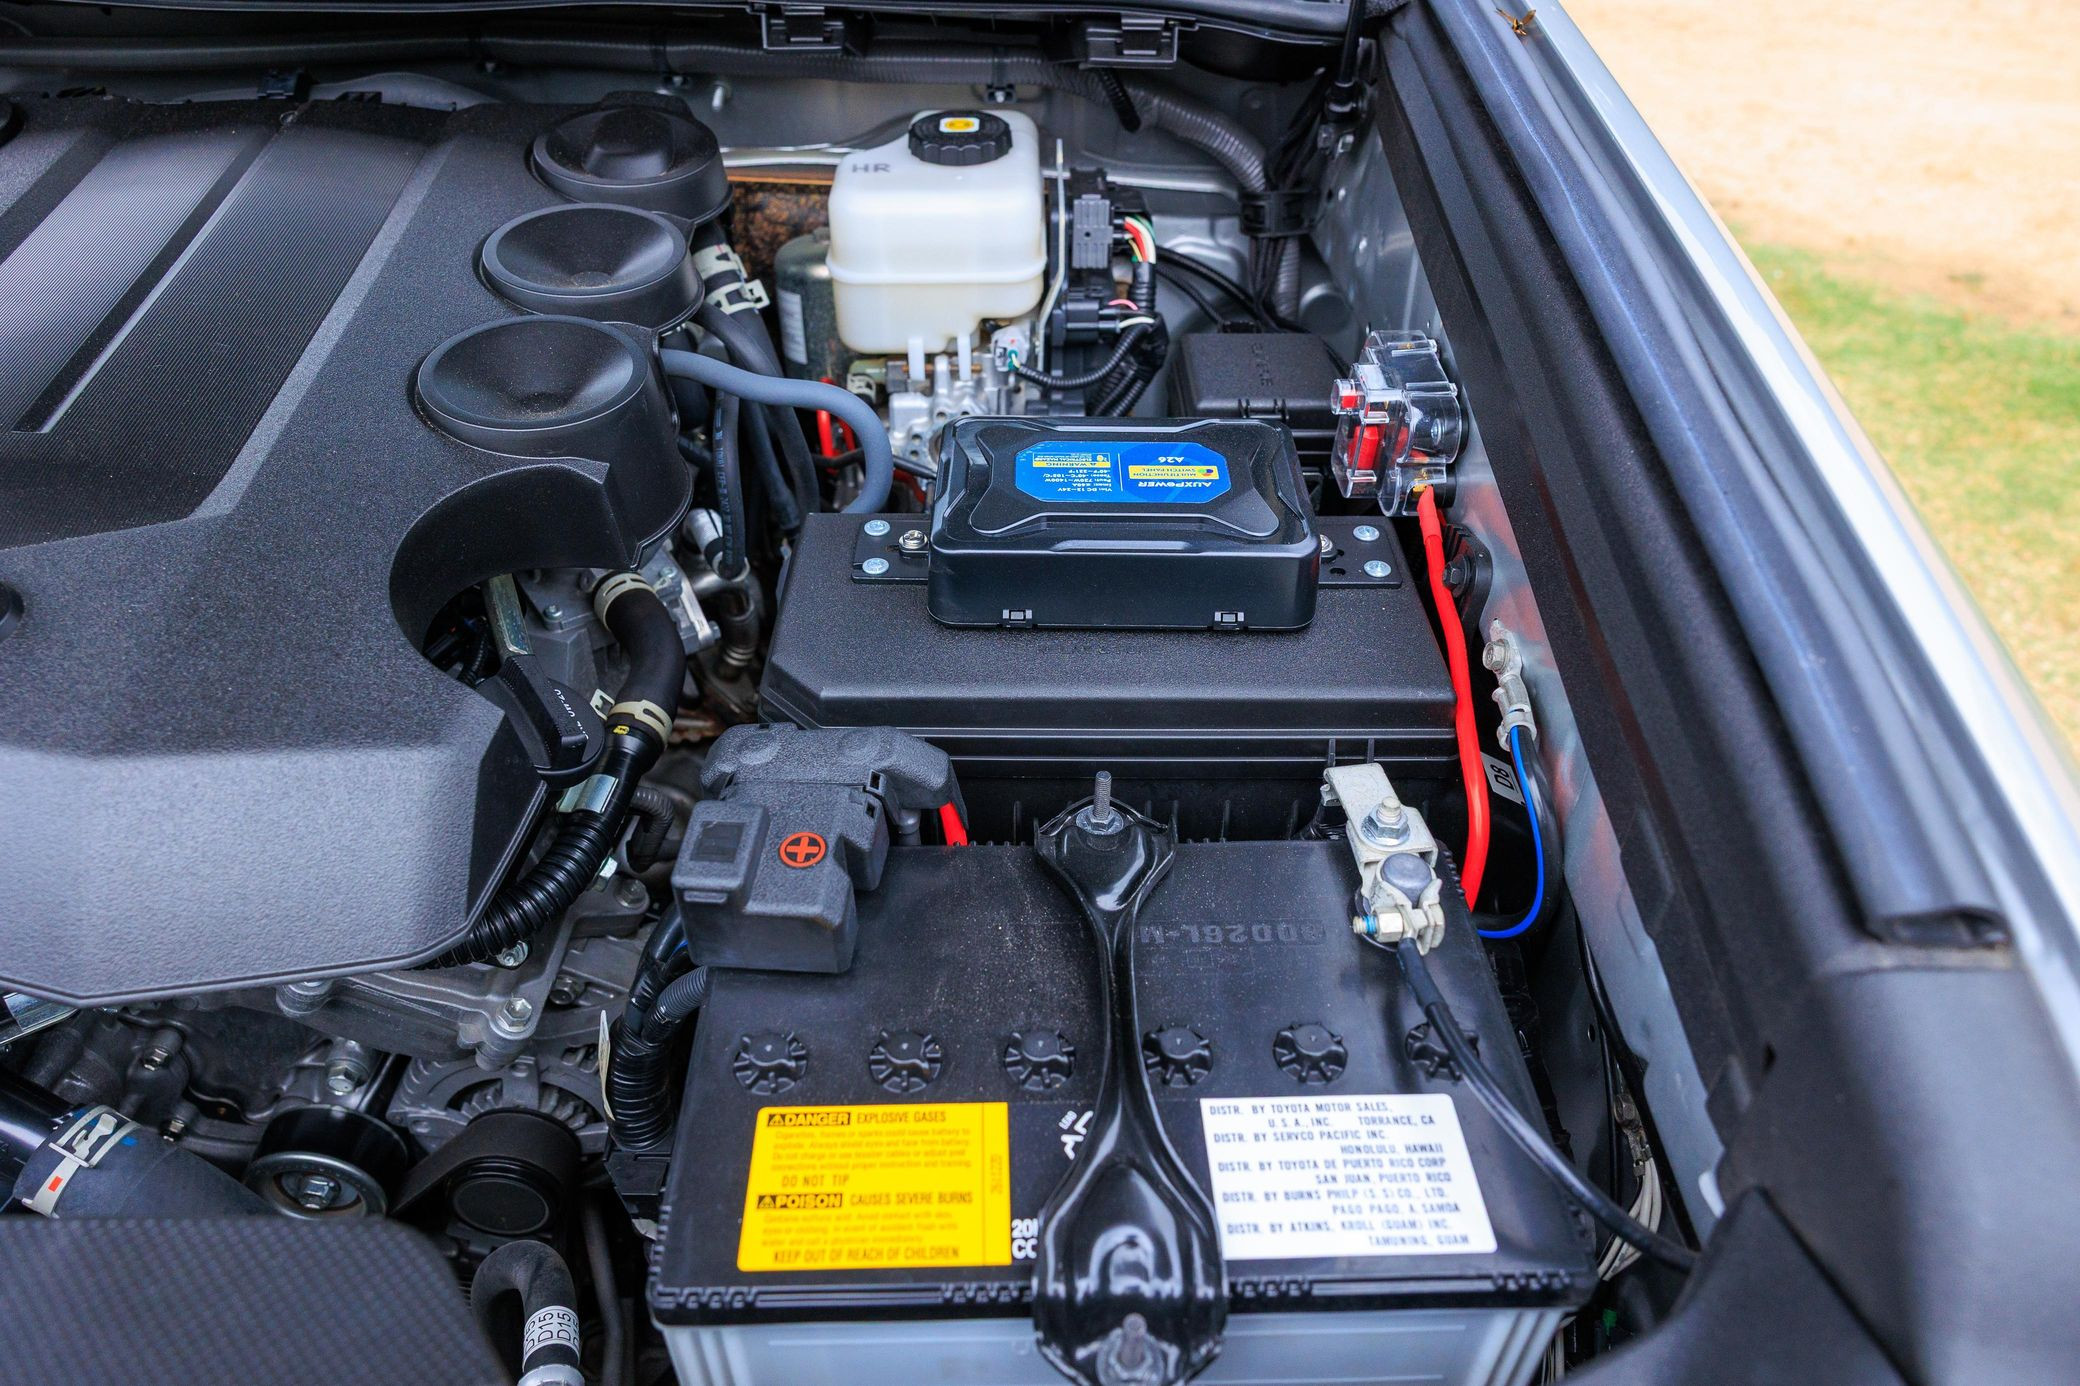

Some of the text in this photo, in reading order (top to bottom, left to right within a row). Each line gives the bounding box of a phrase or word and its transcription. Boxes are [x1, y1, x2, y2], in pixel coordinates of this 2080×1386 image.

[852, 163, 891, 173] HR
[1252, 1104, 1265, 1114] BY
[1271, 1103, 1310, 1113] TOYOTA
[1315, 1102, 1351, 1112] MOTOR
[784, 1110, 947, 1127] DANGER EXPLOSIVE GASES
[1420, 1115, 1435, 1125] CA
[1254, 1132, 1267, 1142] BY
[1320, 1130, 1361, 1140] PACIFIC
[1404, 1143, 1444, 1153] HAWAII
[1259, 1161, 1272, 1171] BY
[1279, 1160, 1319, 1170] TOYOTA
[1324, 1159, 1337, 1169] DE
[1342, 1158, 1384, 1168] PUERTO
[1389, 1157, 1415, 1168] RICO
[781, 1174, 850, 1188] DO NOT TIP
[1315, 1174, 1338, 1184] SAN
[1378, 1172, 1421, 1183] PUERTO
[1425, 1171, 1452, 1182] RICO
[775, 1190, 973, 1208] POISON CAUSES SEVERE BURNS
[1264, 1191, 1277, 1201] BY
[1284, 1190, 1321, 1200] BURNS
[1332, 1204, 1362, 1214] PAGO
[1270, 1223, 1283, 1233] BY
[773, 1246, 960, 1264] KEEP OUT OF REACH OF CHILDREN
[537, 1312, 553, 1343] D15
[556, 1312, 571, 1341] D15
